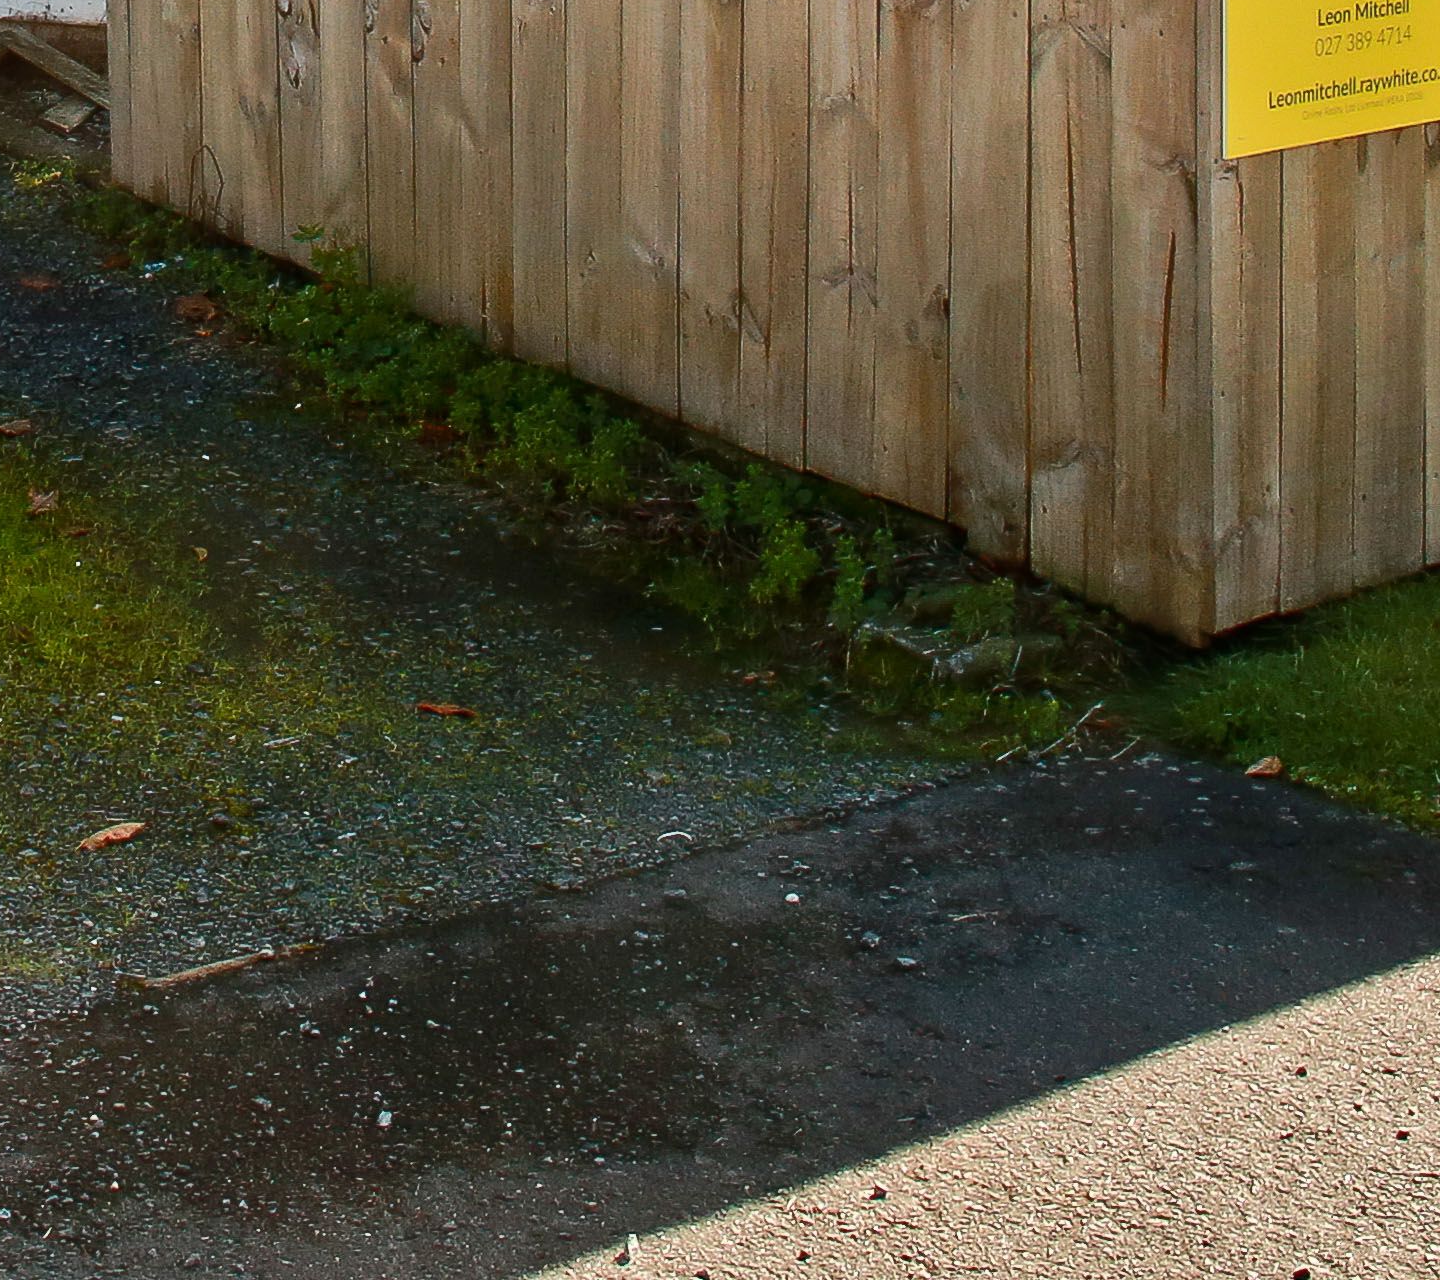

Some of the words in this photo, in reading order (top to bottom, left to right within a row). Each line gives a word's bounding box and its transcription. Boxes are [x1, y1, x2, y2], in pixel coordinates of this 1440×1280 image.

[1318, 9, 1351, 27] Leon
[1314, 36, 1342, 57] 027
[1346, 31, 1373, 52] 389
[1377, 25, 1412, 46] 4714
